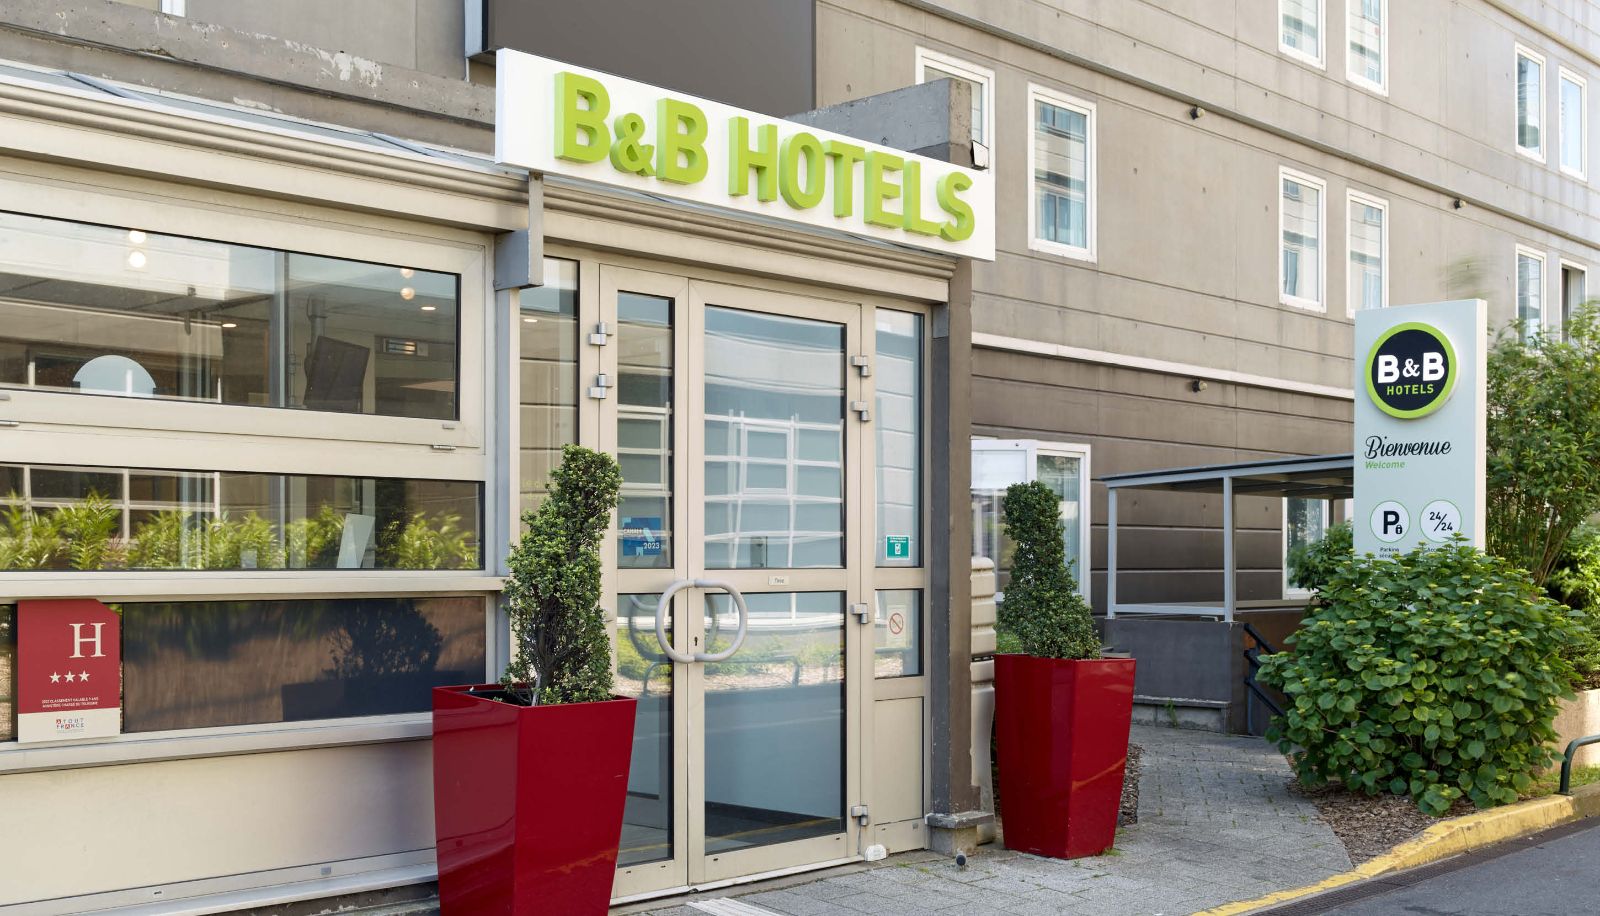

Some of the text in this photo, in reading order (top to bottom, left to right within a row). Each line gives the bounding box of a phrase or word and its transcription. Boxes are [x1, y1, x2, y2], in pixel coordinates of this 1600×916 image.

[553, 71, 976, 243] B&B HOTELS
[1377, 352, 1445, 383] B&B
[1386, 384, 1434, 395] HOTELS
[1364, 435, 1452, 460] Bienvenue
[1365, 461, 1406, 469] Welcome
[1383, 510, 1400, 535] P
[643, 542, 660, 550] 2023
[69, 622, 106, 658] H
